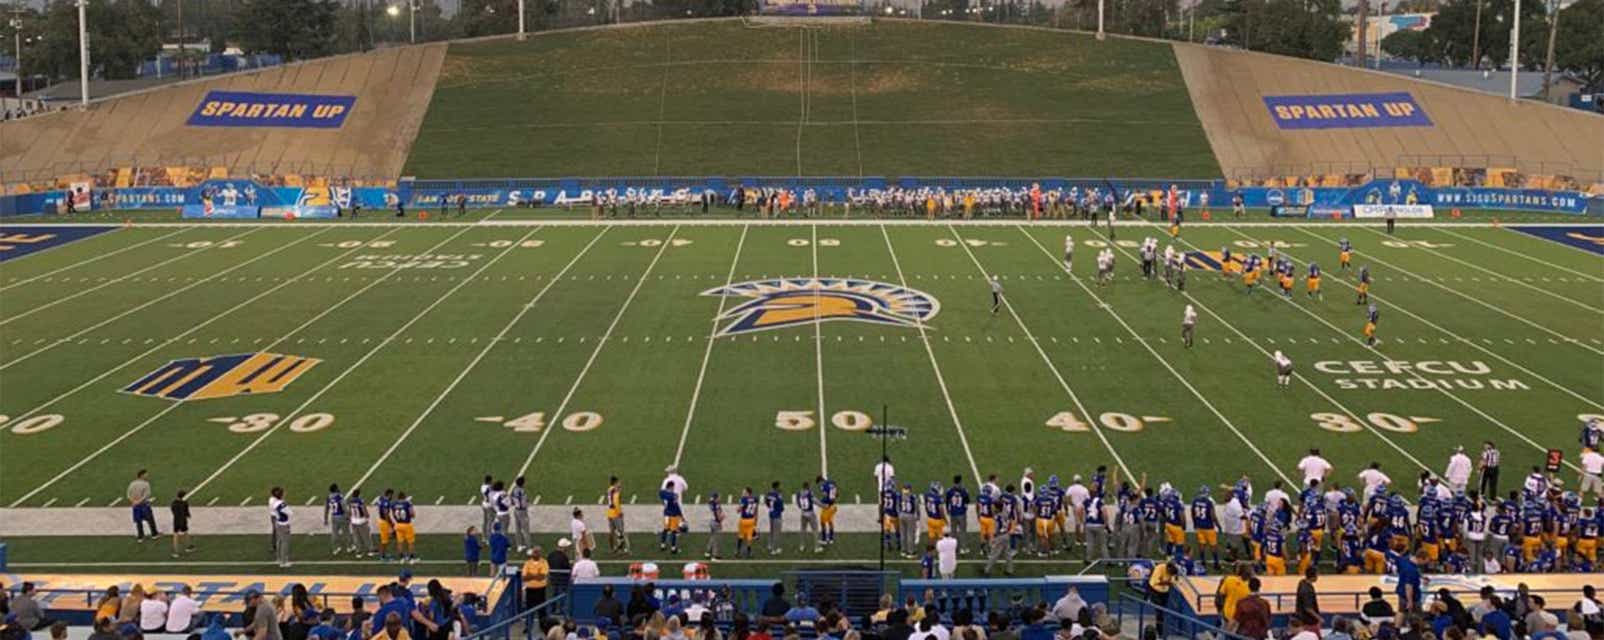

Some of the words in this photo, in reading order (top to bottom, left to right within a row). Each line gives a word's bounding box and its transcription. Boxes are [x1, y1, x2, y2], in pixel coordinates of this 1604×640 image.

[201, 101, 307, 118] SPARTAN
[312, 105, 345, 118] UP
[1275, 103, 1380, 119] SPARTAN
[1384, 102, 1415, 117] UP
[1314, 361, 1491, 374] CEFCU
[1335, 378, 1531, 390] STADIUM
[775, 410, 872, 430] 50
[1548, 451, 1561, 465] 3
